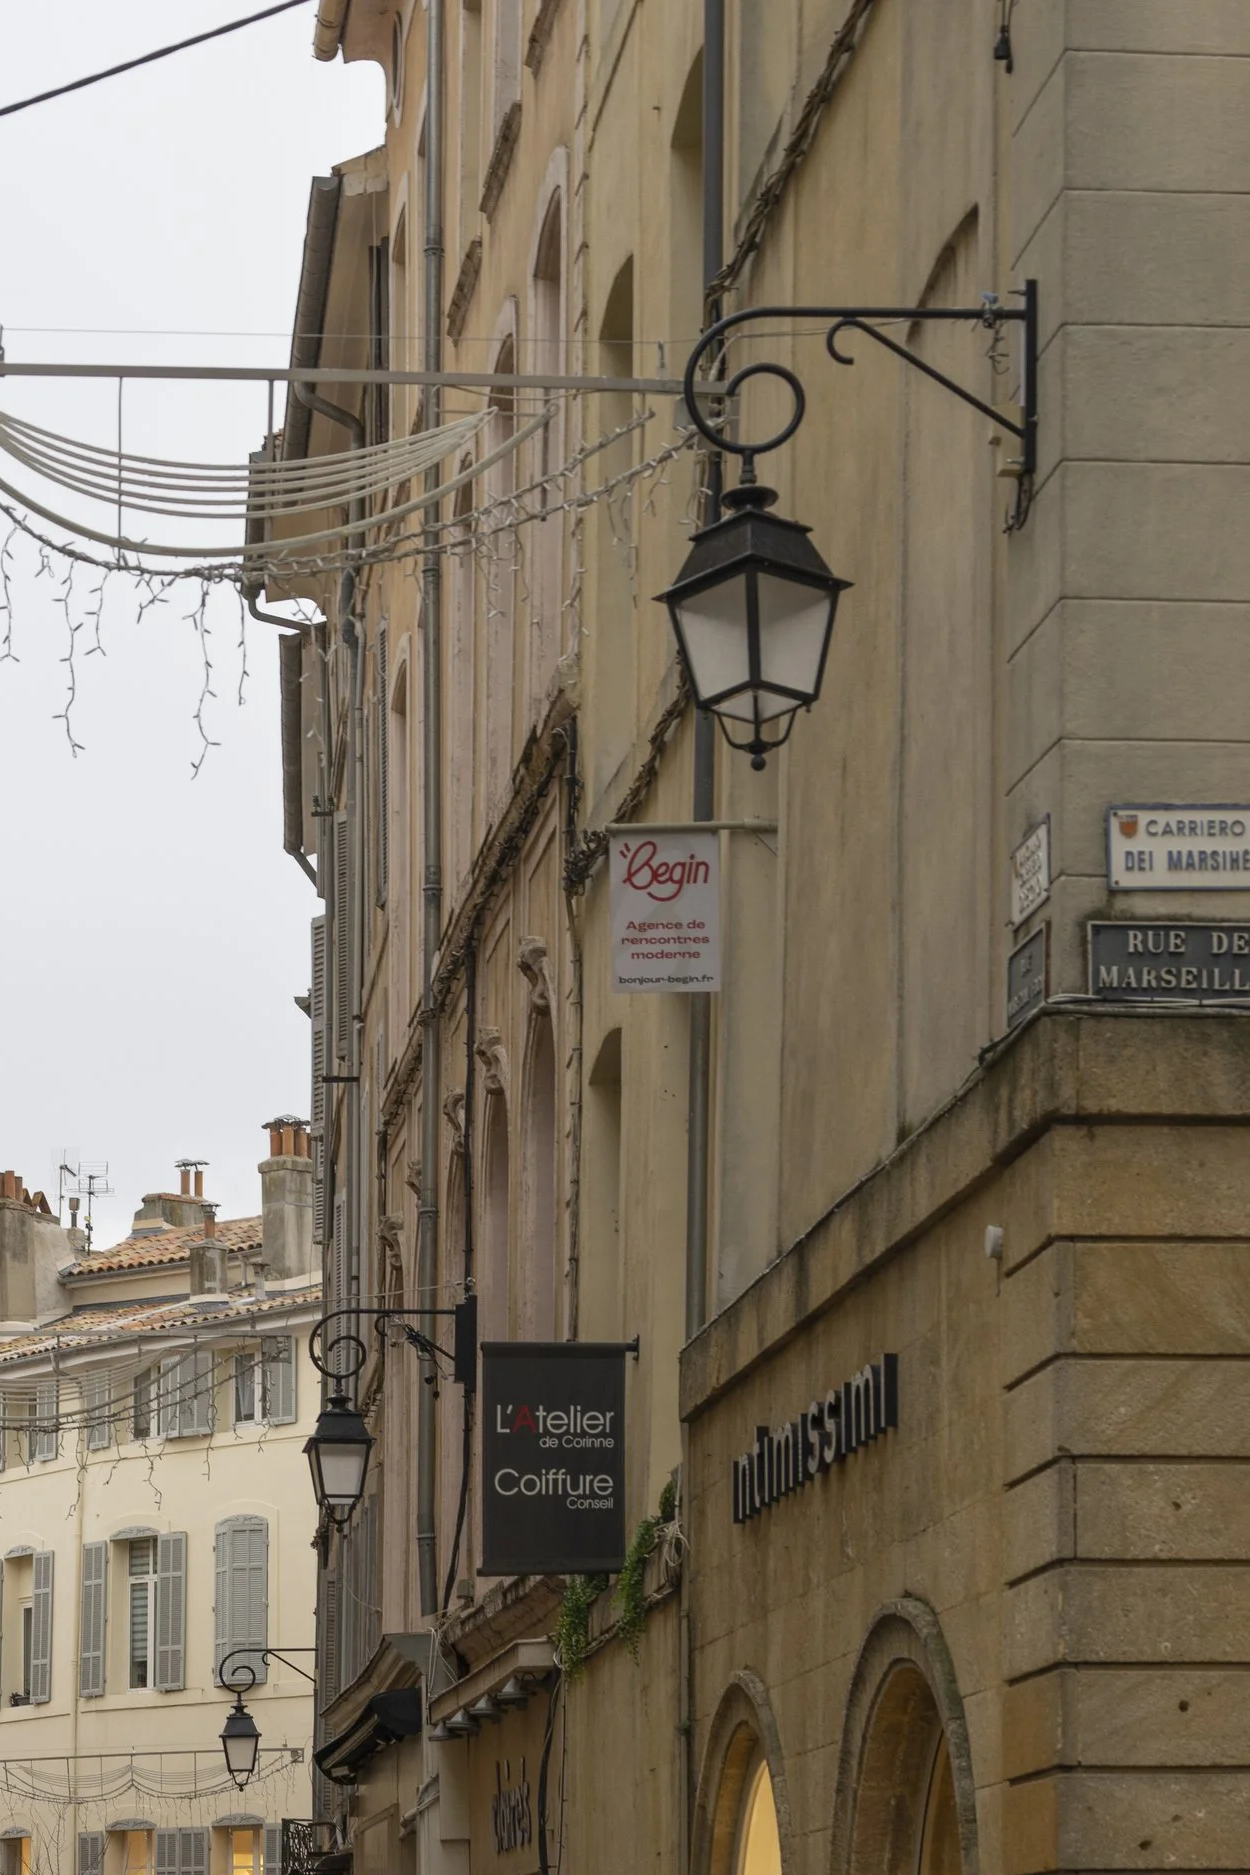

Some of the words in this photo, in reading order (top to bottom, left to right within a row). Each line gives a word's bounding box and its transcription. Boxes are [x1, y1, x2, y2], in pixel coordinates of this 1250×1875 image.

[1145, 819, 1246, 837] CARRIERO
[1124, 850, 1154, 871] DEI
[622, 841, 710, 902] Begin
[626, 921, 683, 932] Agence
[687, 920, 706, 930] de
[621, 935, 710, 945] rencontres
[1127, 930, 1186, 954] RUE
[1211, 932, 1250, 955] DE
[631, 949, 701, 960] moderne
[618, 974, 714, 985] bonjour-begin.fr
[1098, 965, 1250, 991] MARSEILL
[496, 1404, 615, 1434] L'Atelier
[539, 1435, 559, 1448] de
[562, 1435, 615, 1448] Corinne
[732, 1353, 898, 1523] intimissimi
[494, 1468, 614, 1496] Coiffure
[566, 1496, 614, 1509] Conseil
